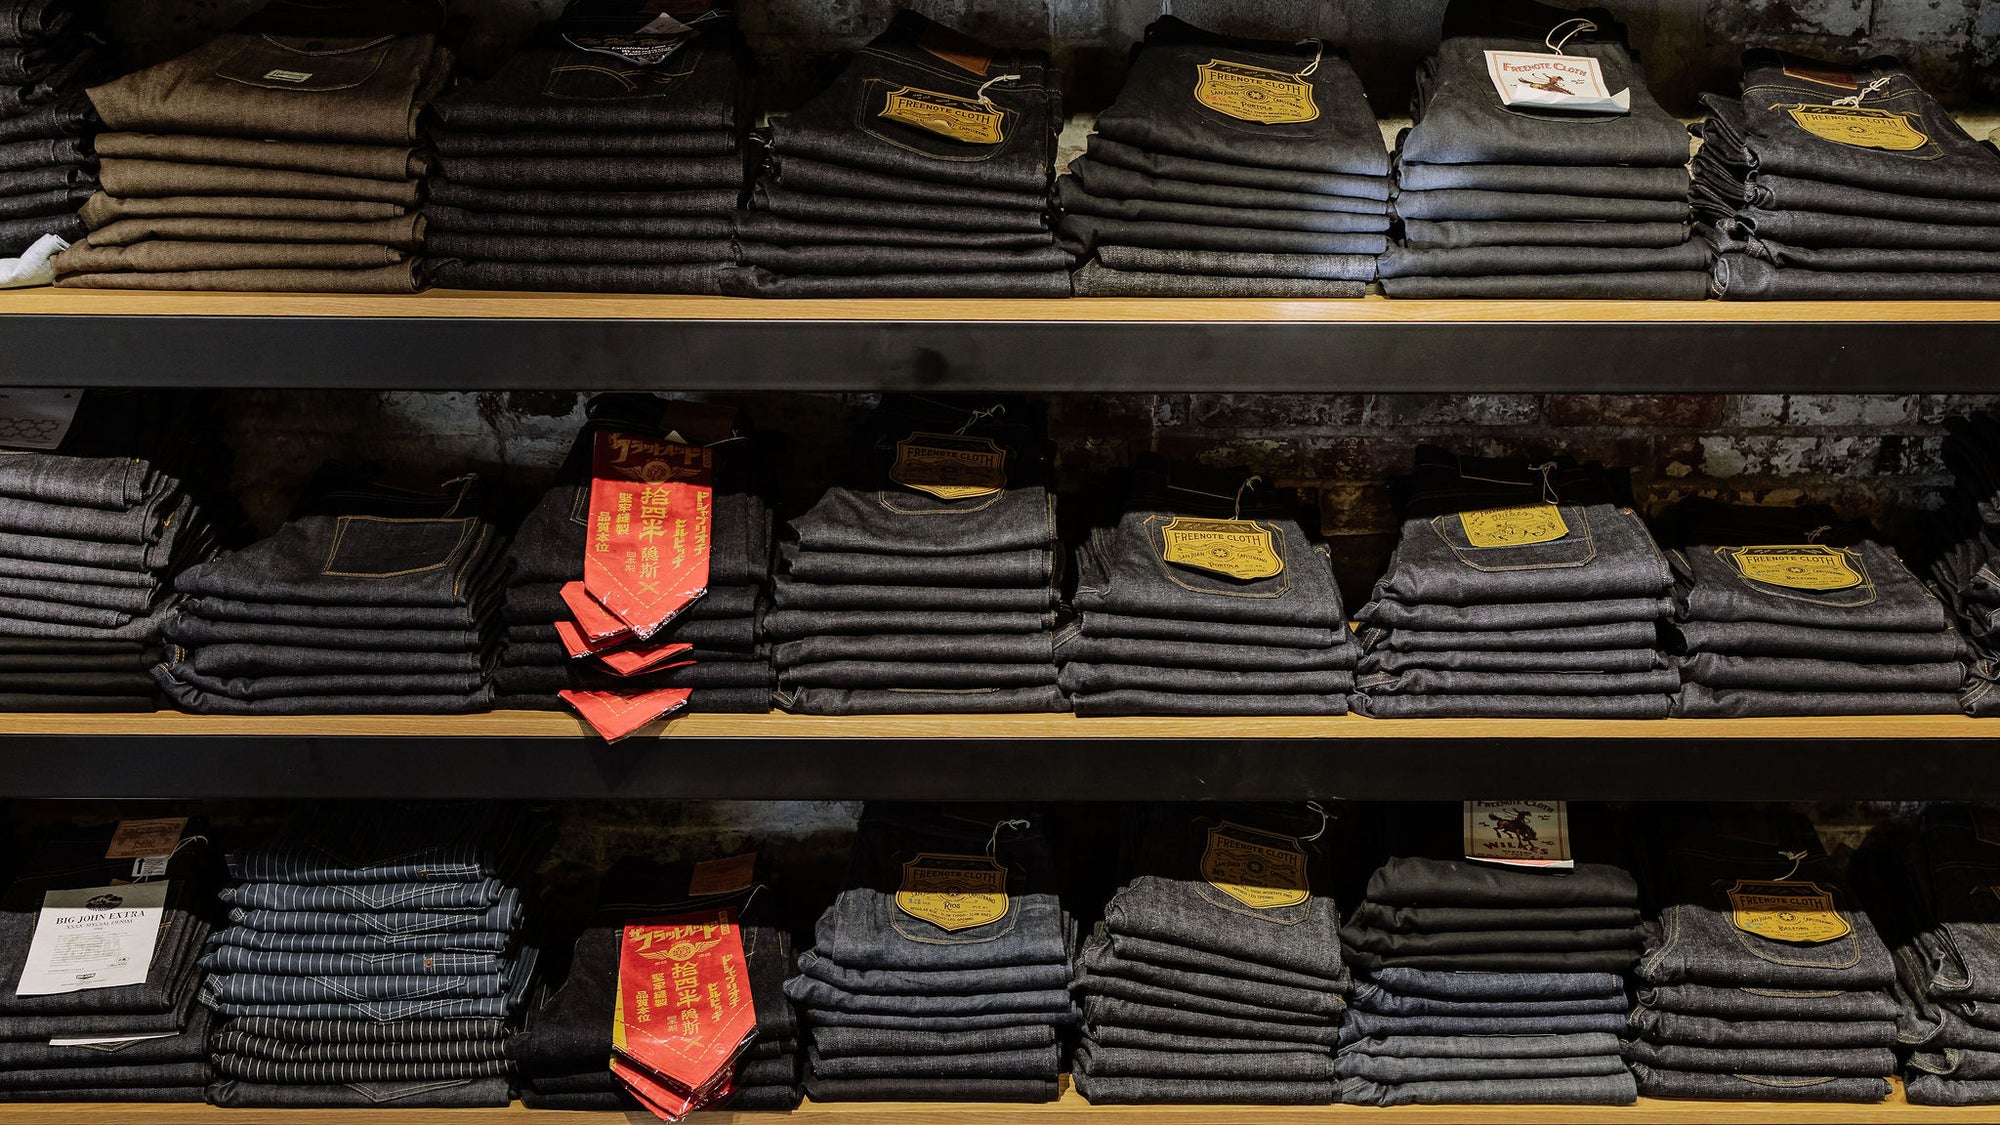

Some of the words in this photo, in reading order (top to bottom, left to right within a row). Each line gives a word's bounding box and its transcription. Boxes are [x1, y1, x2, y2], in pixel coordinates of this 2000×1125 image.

[1503, 62, 1550, 72] FREENOTE
[1553, 62, 1587, 76] CLOTH
[1210, 71, 1262, 85] FREENOTE
[1266, 81, 1300, 95] CLOTH
[898, 99, 952, 113] FREENOTE
[955, 110, 990, 124] CLOTH
[1803, 114, 1857, 122] FREENOTE
[1860, 117, 1898, 127] CLOTH
[907, 447, 957, 459] FREENOTE
[960, 453, 994, 466] CLOTH
[1174, 532, 1224, 543] FREENOTE
[1227, 534, 1261, 546] CLOTH
[1746, 556, 1796, 564] FREENOTE
[1799, 556, 1835, 566] CLOTH
[1524, 800, 1554, 813] CLOTH
[1216, 839, 1263, 853] FREENOTE
[1266, 849, 1297, 866] CLOTH
[1483, 841, 1549, 855] WILKES
[913, 869, 961, 880] FREENOTE
[963, 871, 996, 884] CLOTH
[1740, 896, 1787, 907] FREENOTE
[1789, 897, 1824, 909] CLOTH
[56, 916, 75, 925] BIG
[77, 913, 106, 924] JOHN
[109, 910, 146, 920] EXTRA
